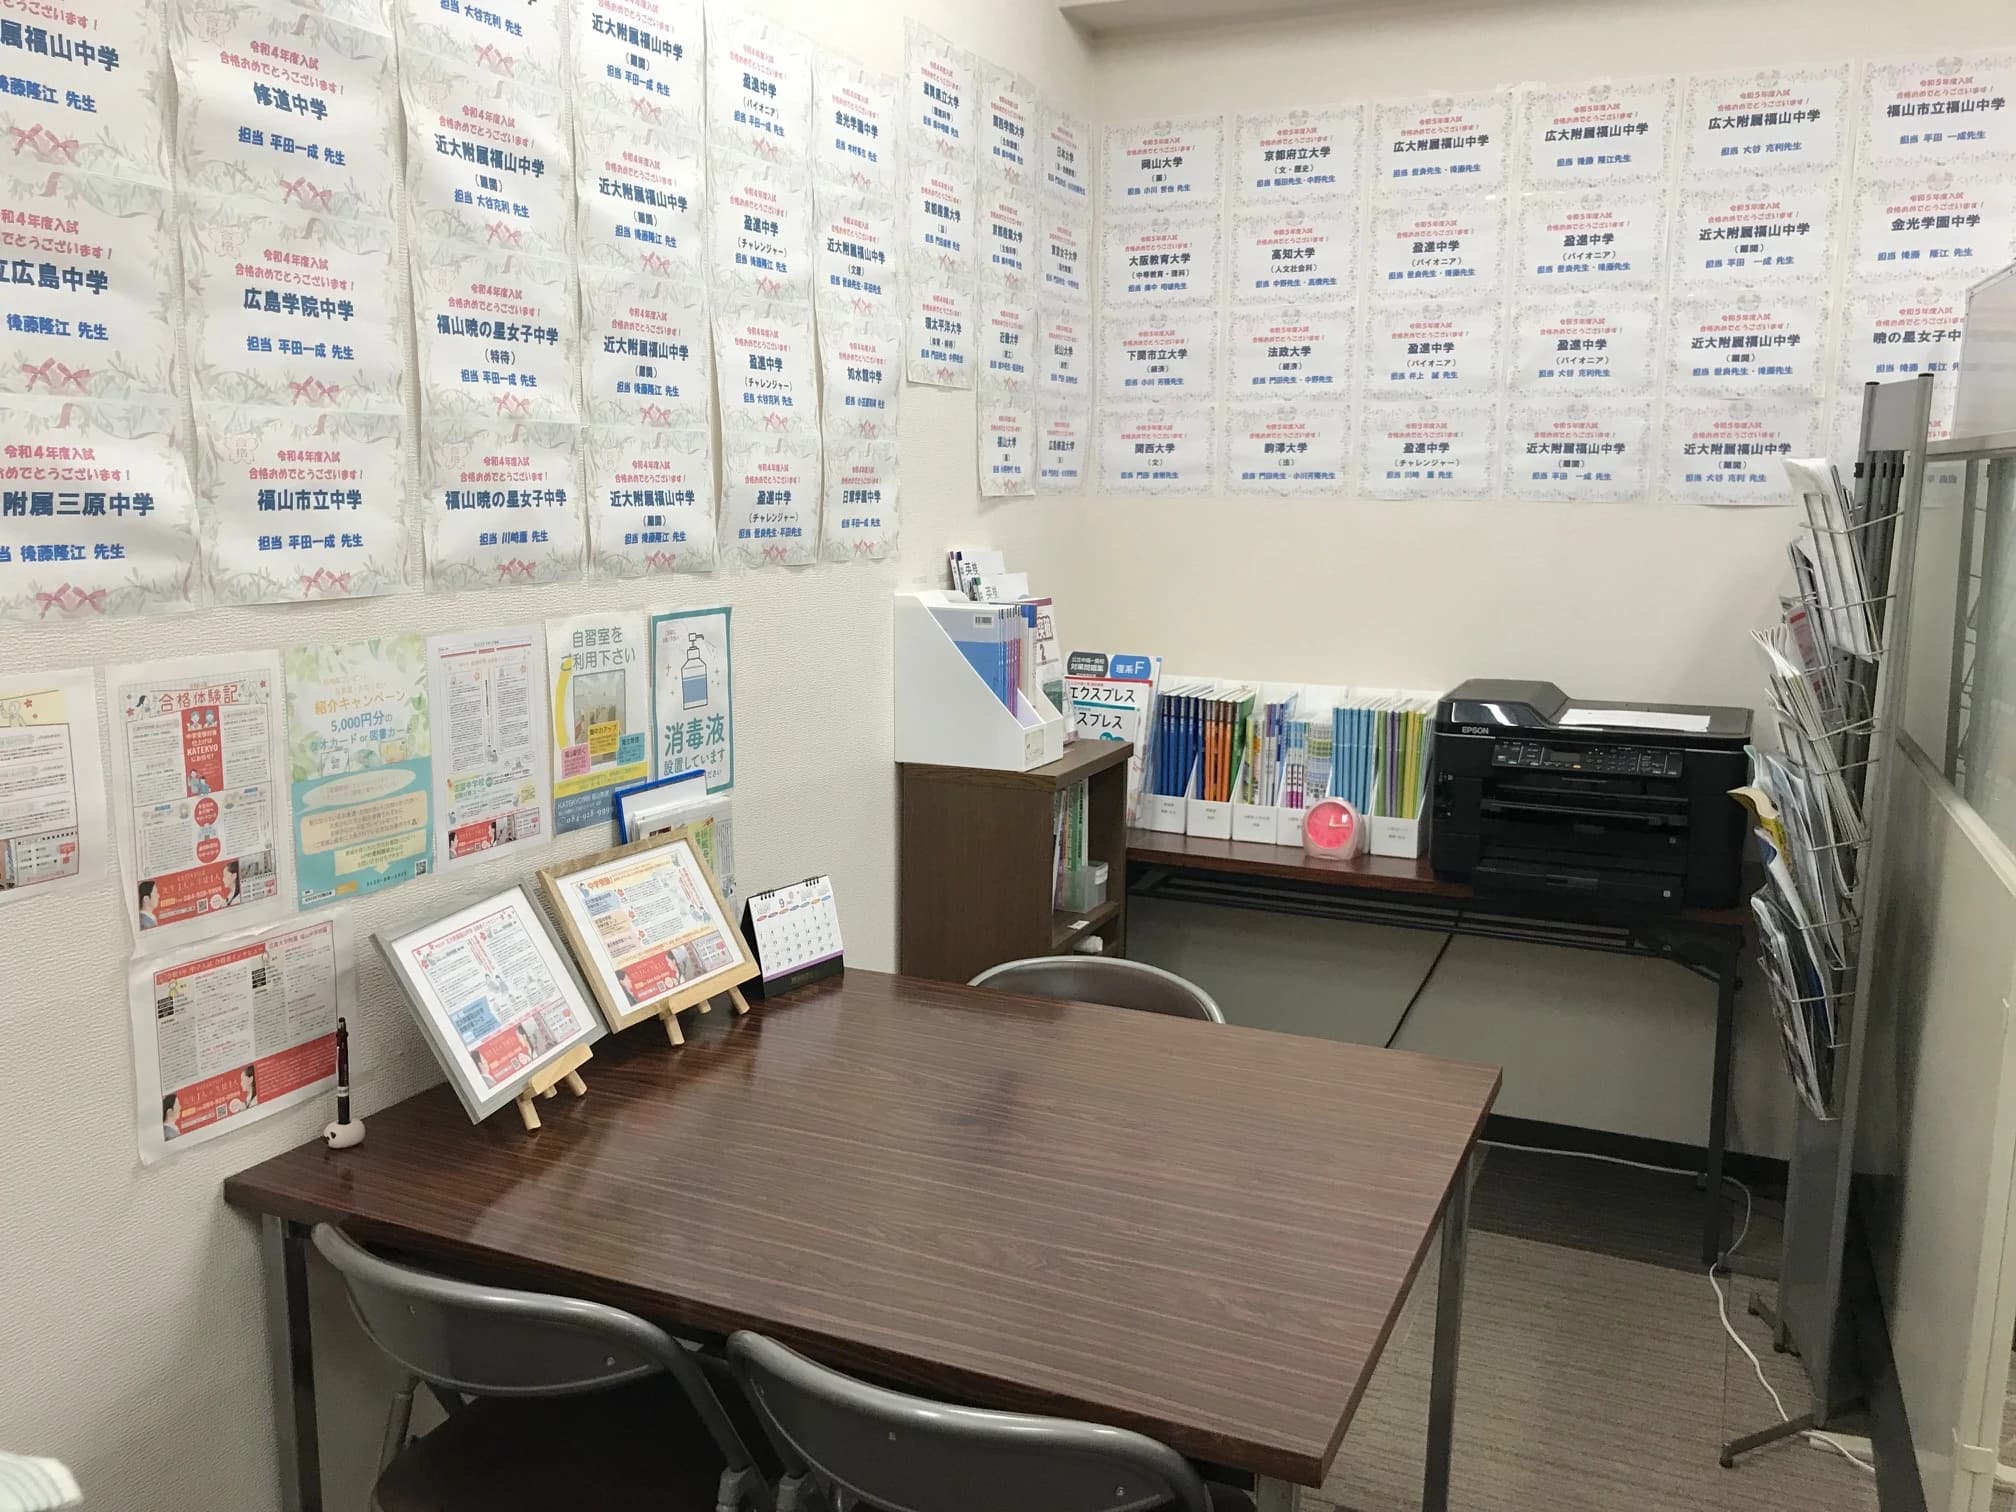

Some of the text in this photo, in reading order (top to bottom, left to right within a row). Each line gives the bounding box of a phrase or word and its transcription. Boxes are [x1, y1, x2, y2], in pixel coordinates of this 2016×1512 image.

[505, 19, 523, 37] 先生
[250, 40, 319, 71] 令和4年度入試
[219, 51, 344, 95] 合格おめでとうございます！
[607, 64, 621, 80] 担当
[657, 82, 670, 96] 先生
[66, 90, 97, 113] 先生
[253, 81, 328, 121] 修道中学
[1886, 97, 2005, 118] 福山市立福山中学
[462, 105, 515, 128] 令和4年度入試
[1708, 109, 1820, 130] 広大附属福山中学
[439, 115, 535, 148] 合格おめでとうございます！
[238, 125, 346, 167] 担当 平田一成 先生
[434, 134, 545, 178] 近大附属福山中学
[1264, 146, 1331, 162] 京都府立大学
[454, 188, 473, 204] 担当
[513, 203, 530, 218] 先生
[0, 208, 79, 235] 和4年度入試
[1699, 222, 1810, 241] 近大附属福山中学
[1891, 214, 1980, 231] 金光学園中学
[615, 225, 677, 248] 担当 先生
[263, 248, 329, 271] 令和4年度入試
[235, 263, 354, 291] 合格おめでとうございます！
[471, 283, 522, 300] 令和4年度入試
[243, 287, 354, 321] 広島学院中学
[448, 296, 541, 317] 合格おめでとうございます！
[78, 321, 109, 341] 先生
[437, 314, 559, 346] 福山暁の星女子中学
[246, 336, 354, 361] 担当 平田一成 先生
[1691, 334, 1801, 350] 近大附属福山中学
[461, 369, 537, 388] 担当 平田一成 先生
[617, 382, 679, 397] 担当 先生
[5, 445, 95, 461] 令和4年度入試
[277, 450, 340, 464] 令和4年度入試
[1683, 442, 1792, 456] 近大附属福山中学
[483, 456, 530, 466] 令和4年度入試
[249, 467, 363, 481] 合格おめでとうございます！
[460, 472, 548, 483] 合格おめでとうございます！
[3, 491, 155, 517] 附属三原中学
[257, 488, 362, 511] 福山市立中学
[445, 489, 567, 510] 福山暁の星女子中学
[258, 534, 364, 551] 担当 平田一成 先生
[479, 531, 548, 546] 担当 先生
[624, 531, 687, 545] 担当 先生
[94, 543, 125, 560] 先生
[573, 626, 623, 648] 自習室を
[560, 648, 636, 672] ご利用下さい
[159, 684, 240, 712] 合格体験記
[1070, 686, 1136, 703] エクスプレス
[1076, 712, 1123, 730] スプレス
[1463, 726, 1489, 735] EPSON
[664, 712, 726, 756] 消毒液
[664, 748, 727, 776] 設置しています
[778, 897, 785, 908] 9
